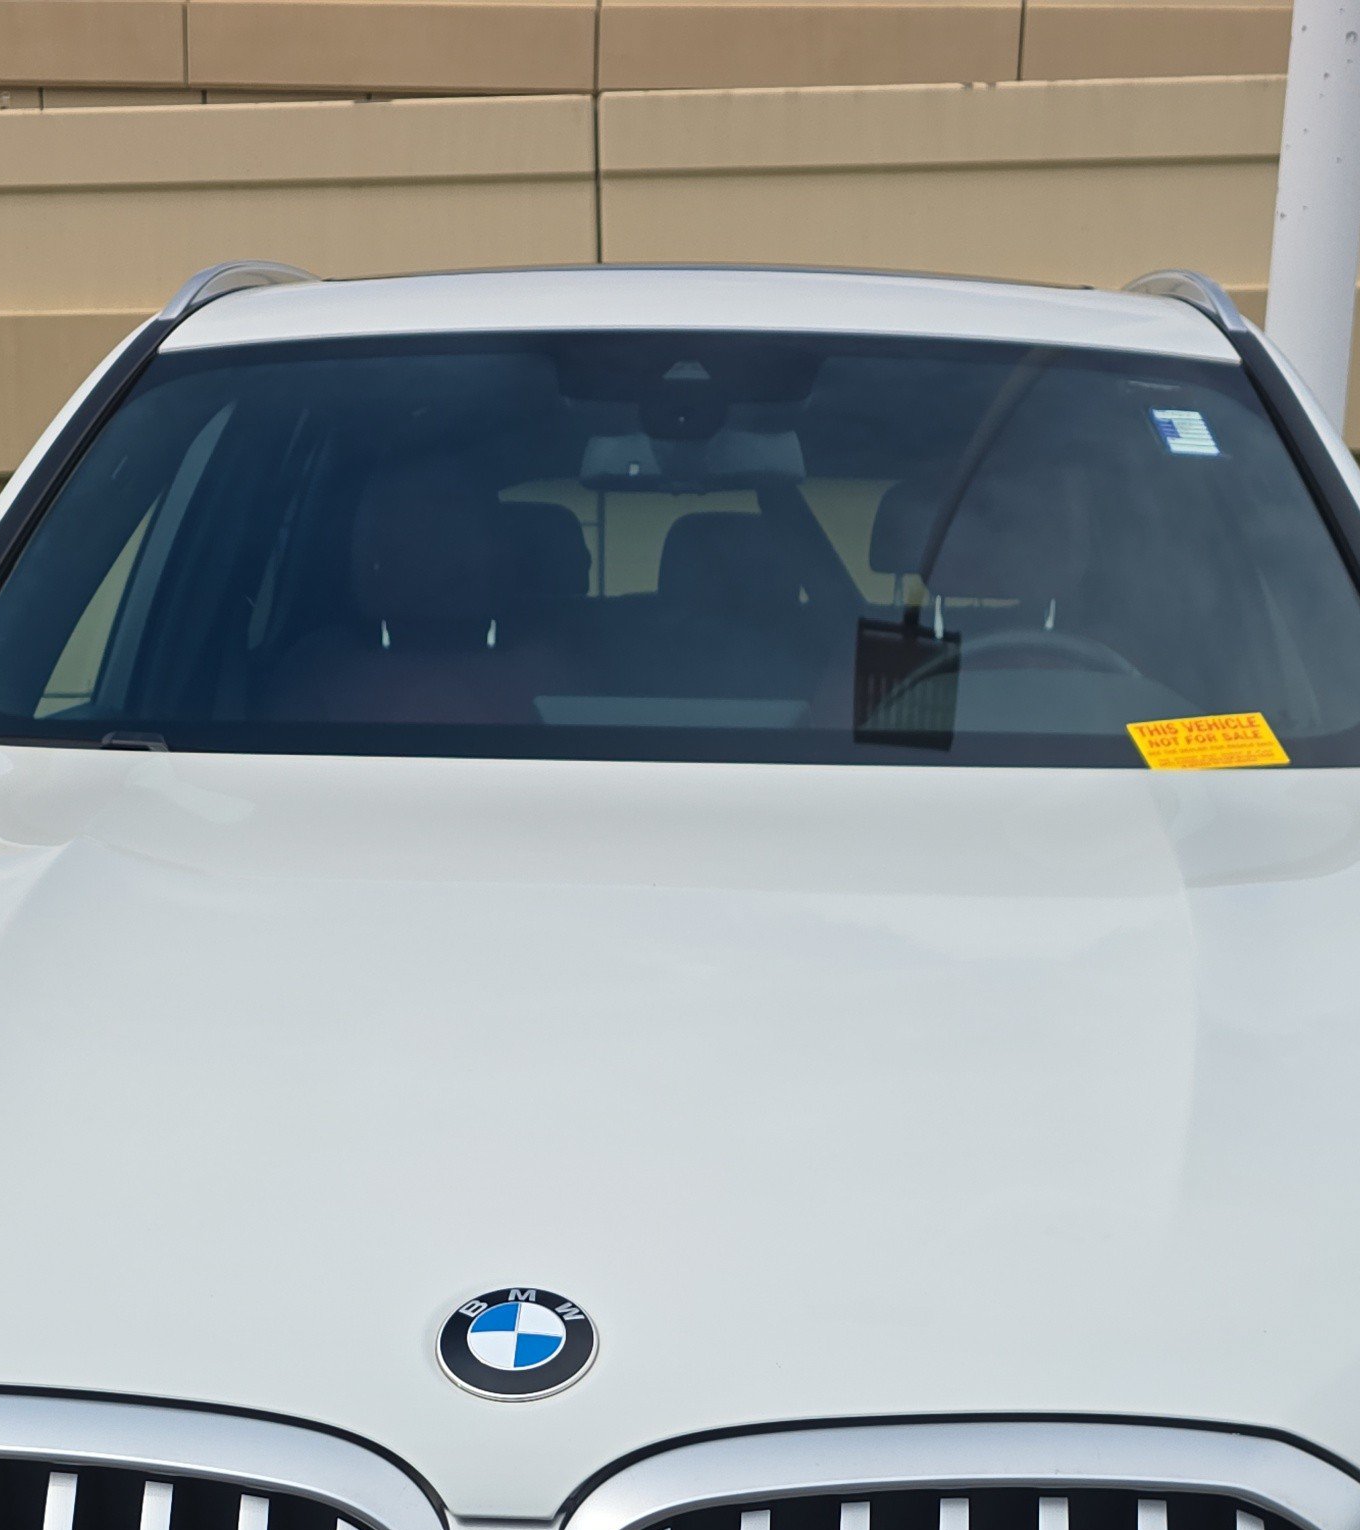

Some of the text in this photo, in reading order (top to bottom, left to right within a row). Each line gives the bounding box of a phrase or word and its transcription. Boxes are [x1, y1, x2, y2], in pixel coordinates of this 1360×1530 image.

[1134, 715, 1261, 737] THIS VEHICLE
[1148, 730, 1263, 748] NOT FOR SALE
[459, 1289, 585, 1321] BMW
